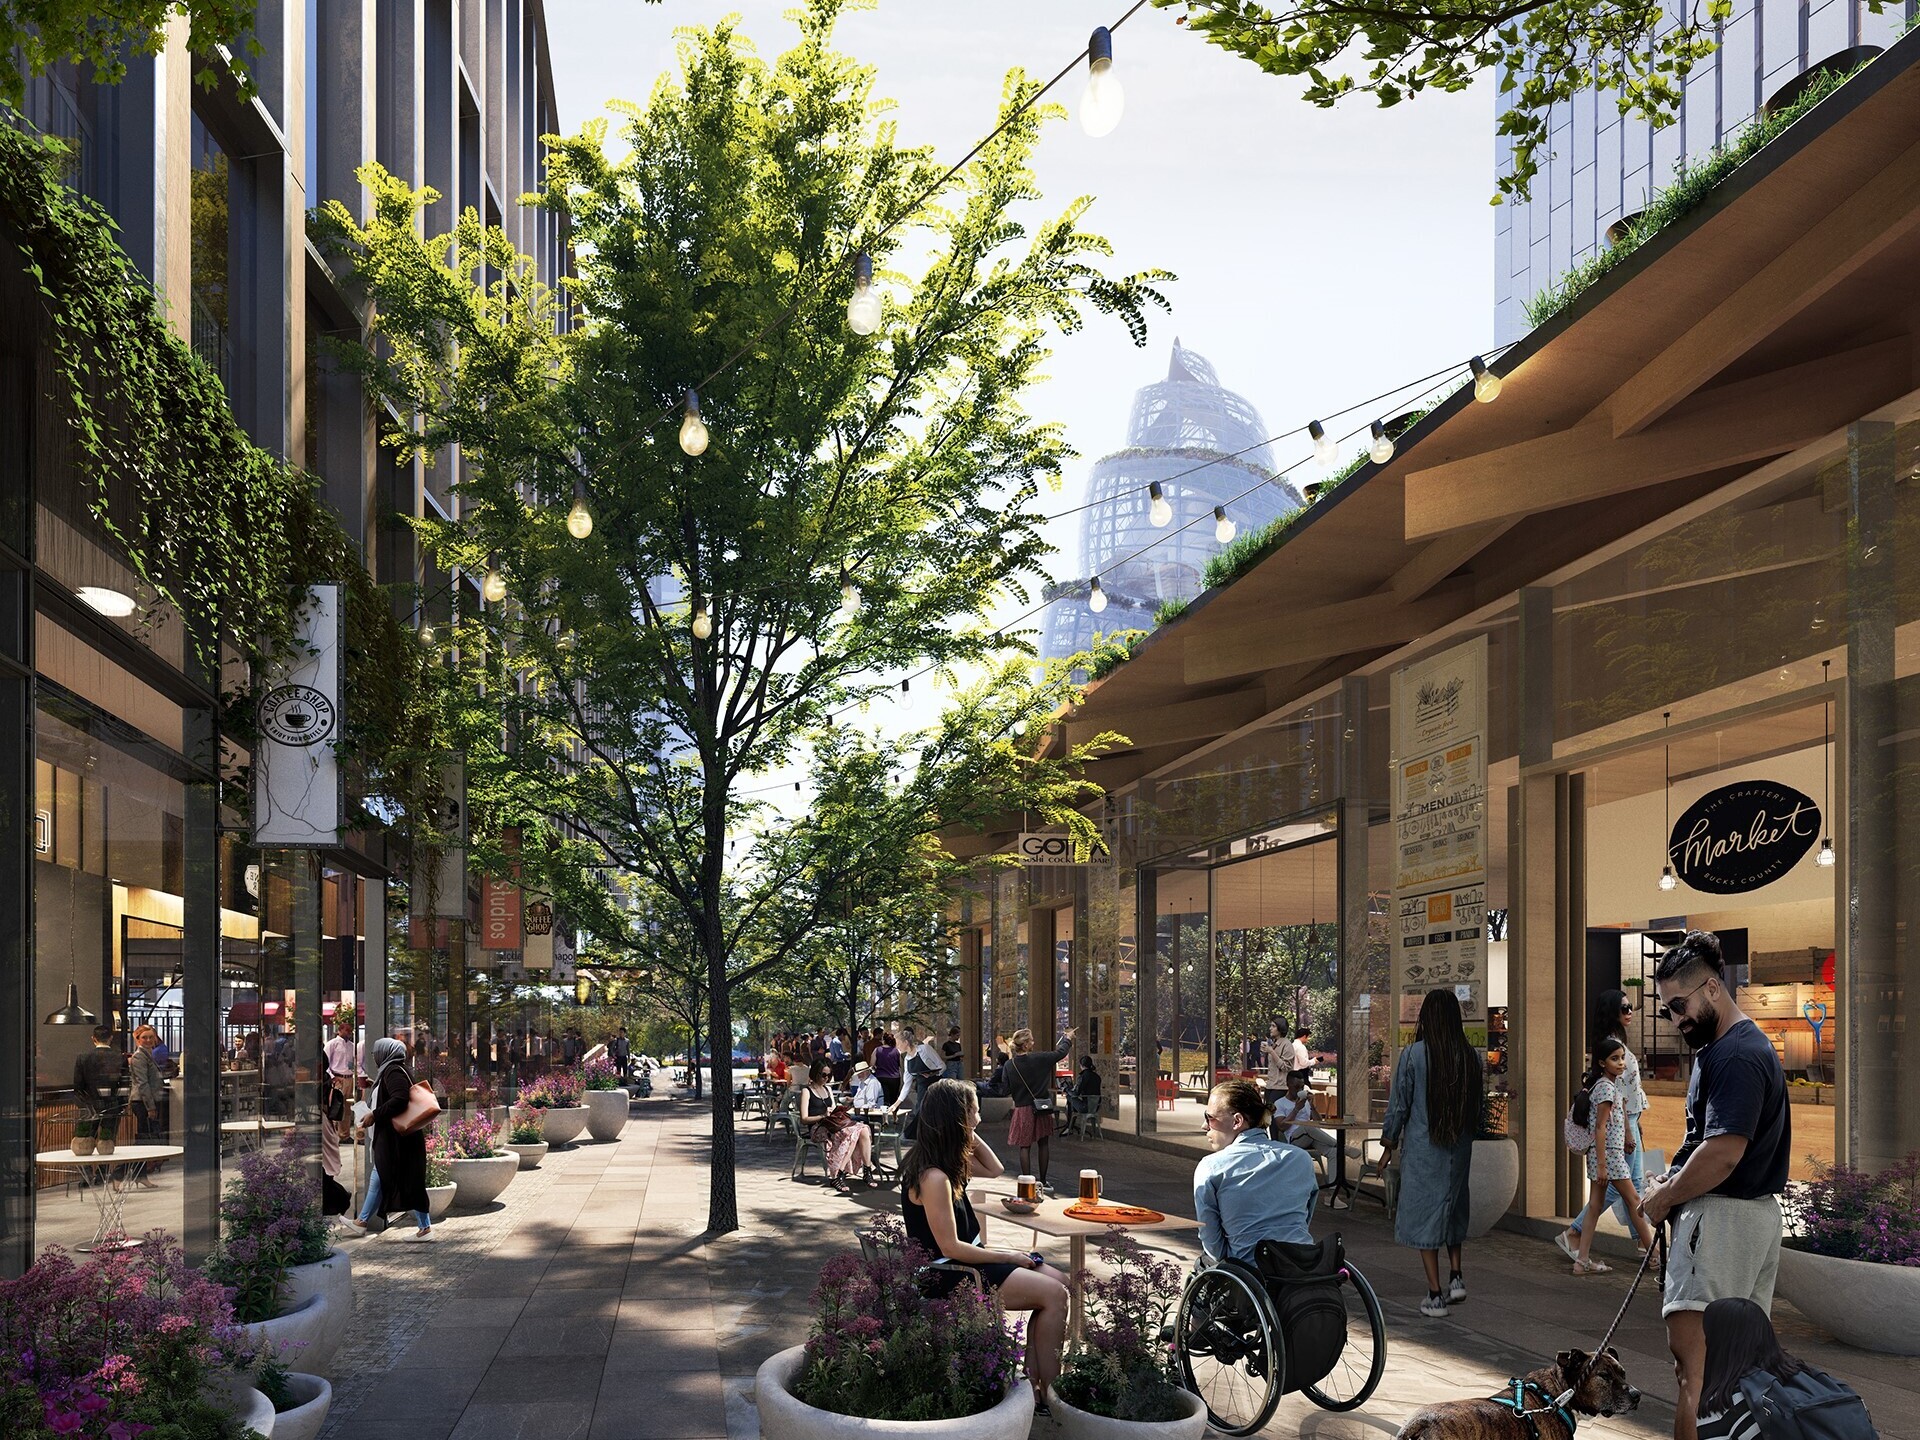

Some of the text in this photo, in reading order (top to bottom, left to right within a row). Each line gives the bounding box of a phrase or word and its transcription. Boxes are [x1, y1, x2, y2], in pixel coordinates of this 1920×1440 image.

[304, 690, 330, 714] SHOP
[269, 726, 287, 739] ENJOY
[303, 727, 323, 741] OFFEE
[1421, 796, 1454, 814] MENU
[1704, 789, 1786, 813] THE CRAFTERY
[1432, 838, 1448, 849] DRINKS
[1457, 831, 1475, 843] BRUNCH
[1703, 859, 1784, 885] BUCKS COUNTY
[1434, 933, 1446, 943] EGGS
